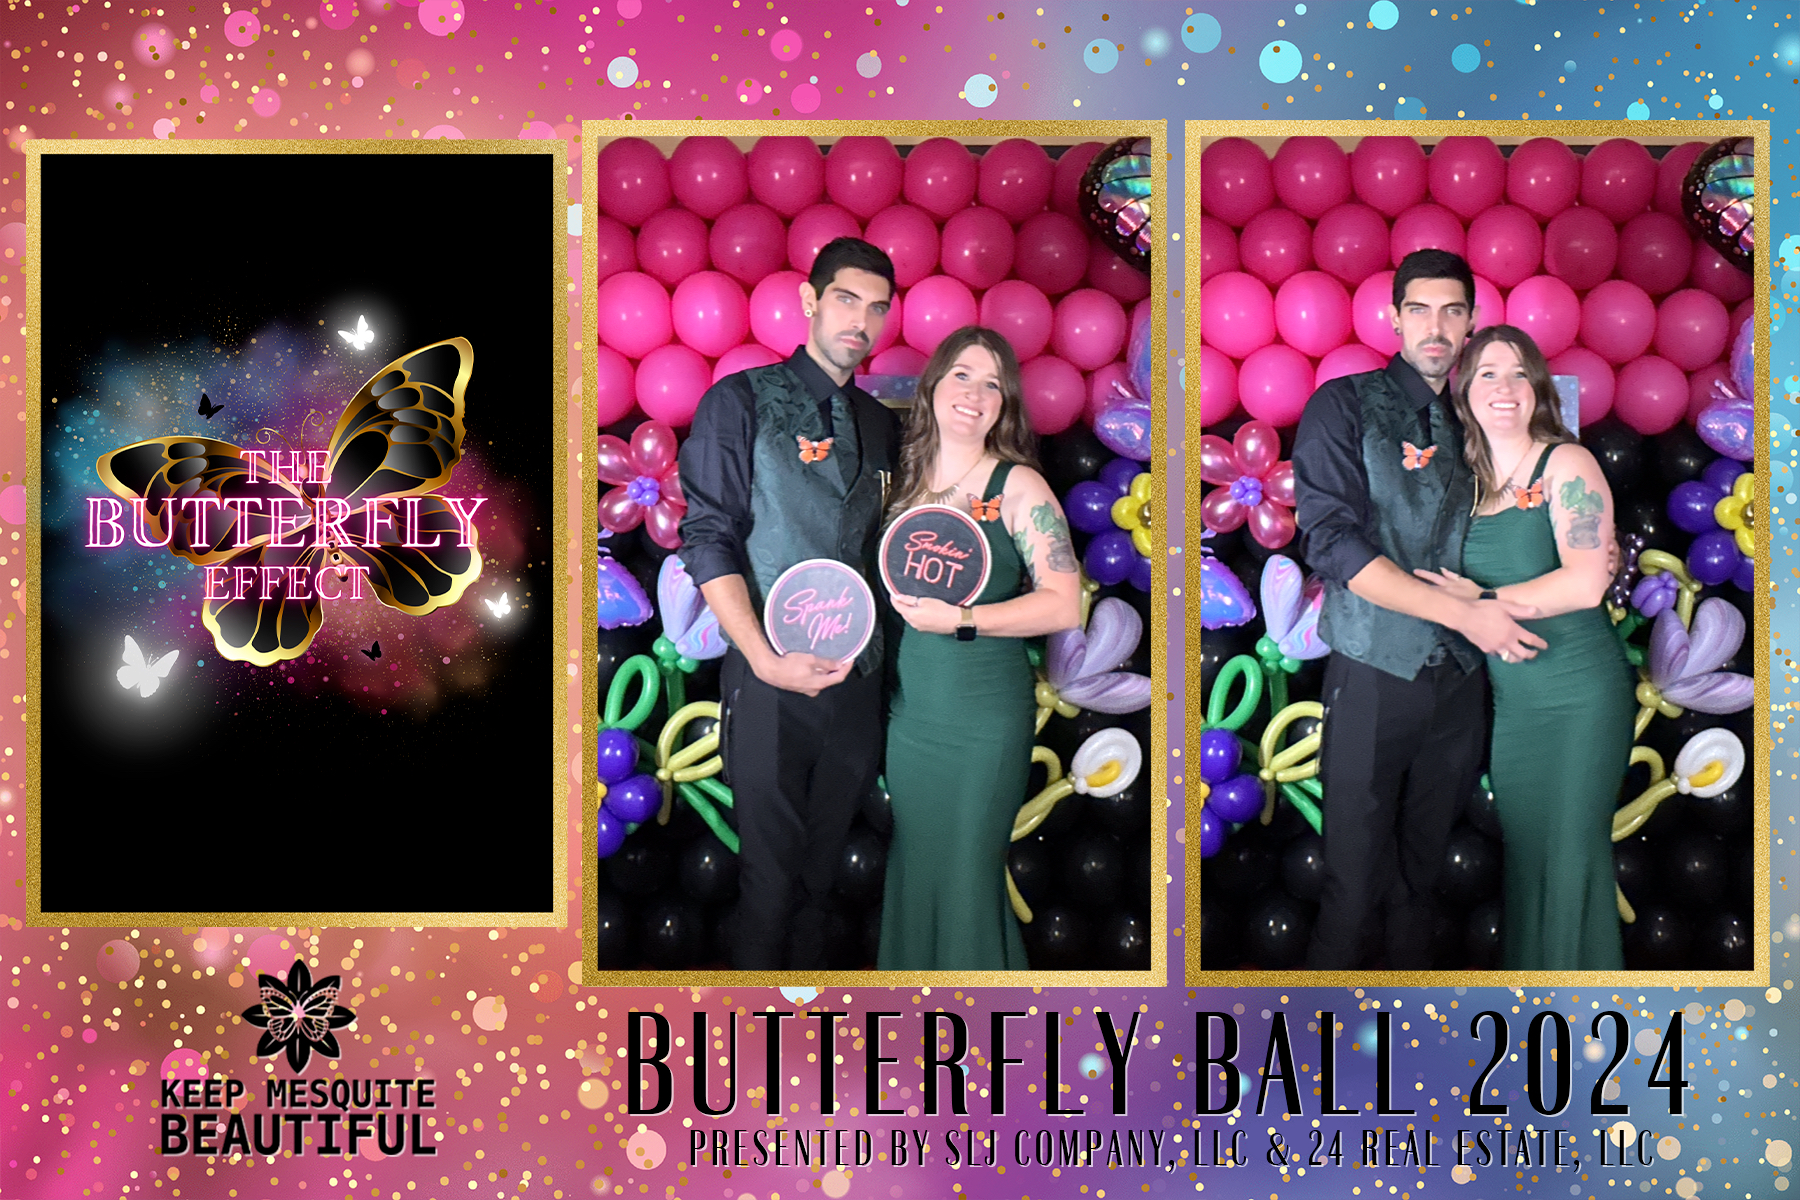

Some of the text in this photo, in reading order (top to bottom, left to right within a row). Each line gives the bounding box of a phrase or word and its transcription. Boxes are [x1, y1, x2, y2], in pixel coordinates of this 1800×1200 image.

[904, 551, 964, 588] HOT
[783, 586, 854, 625] Spank
[807, 612, 853, 650] Me!
